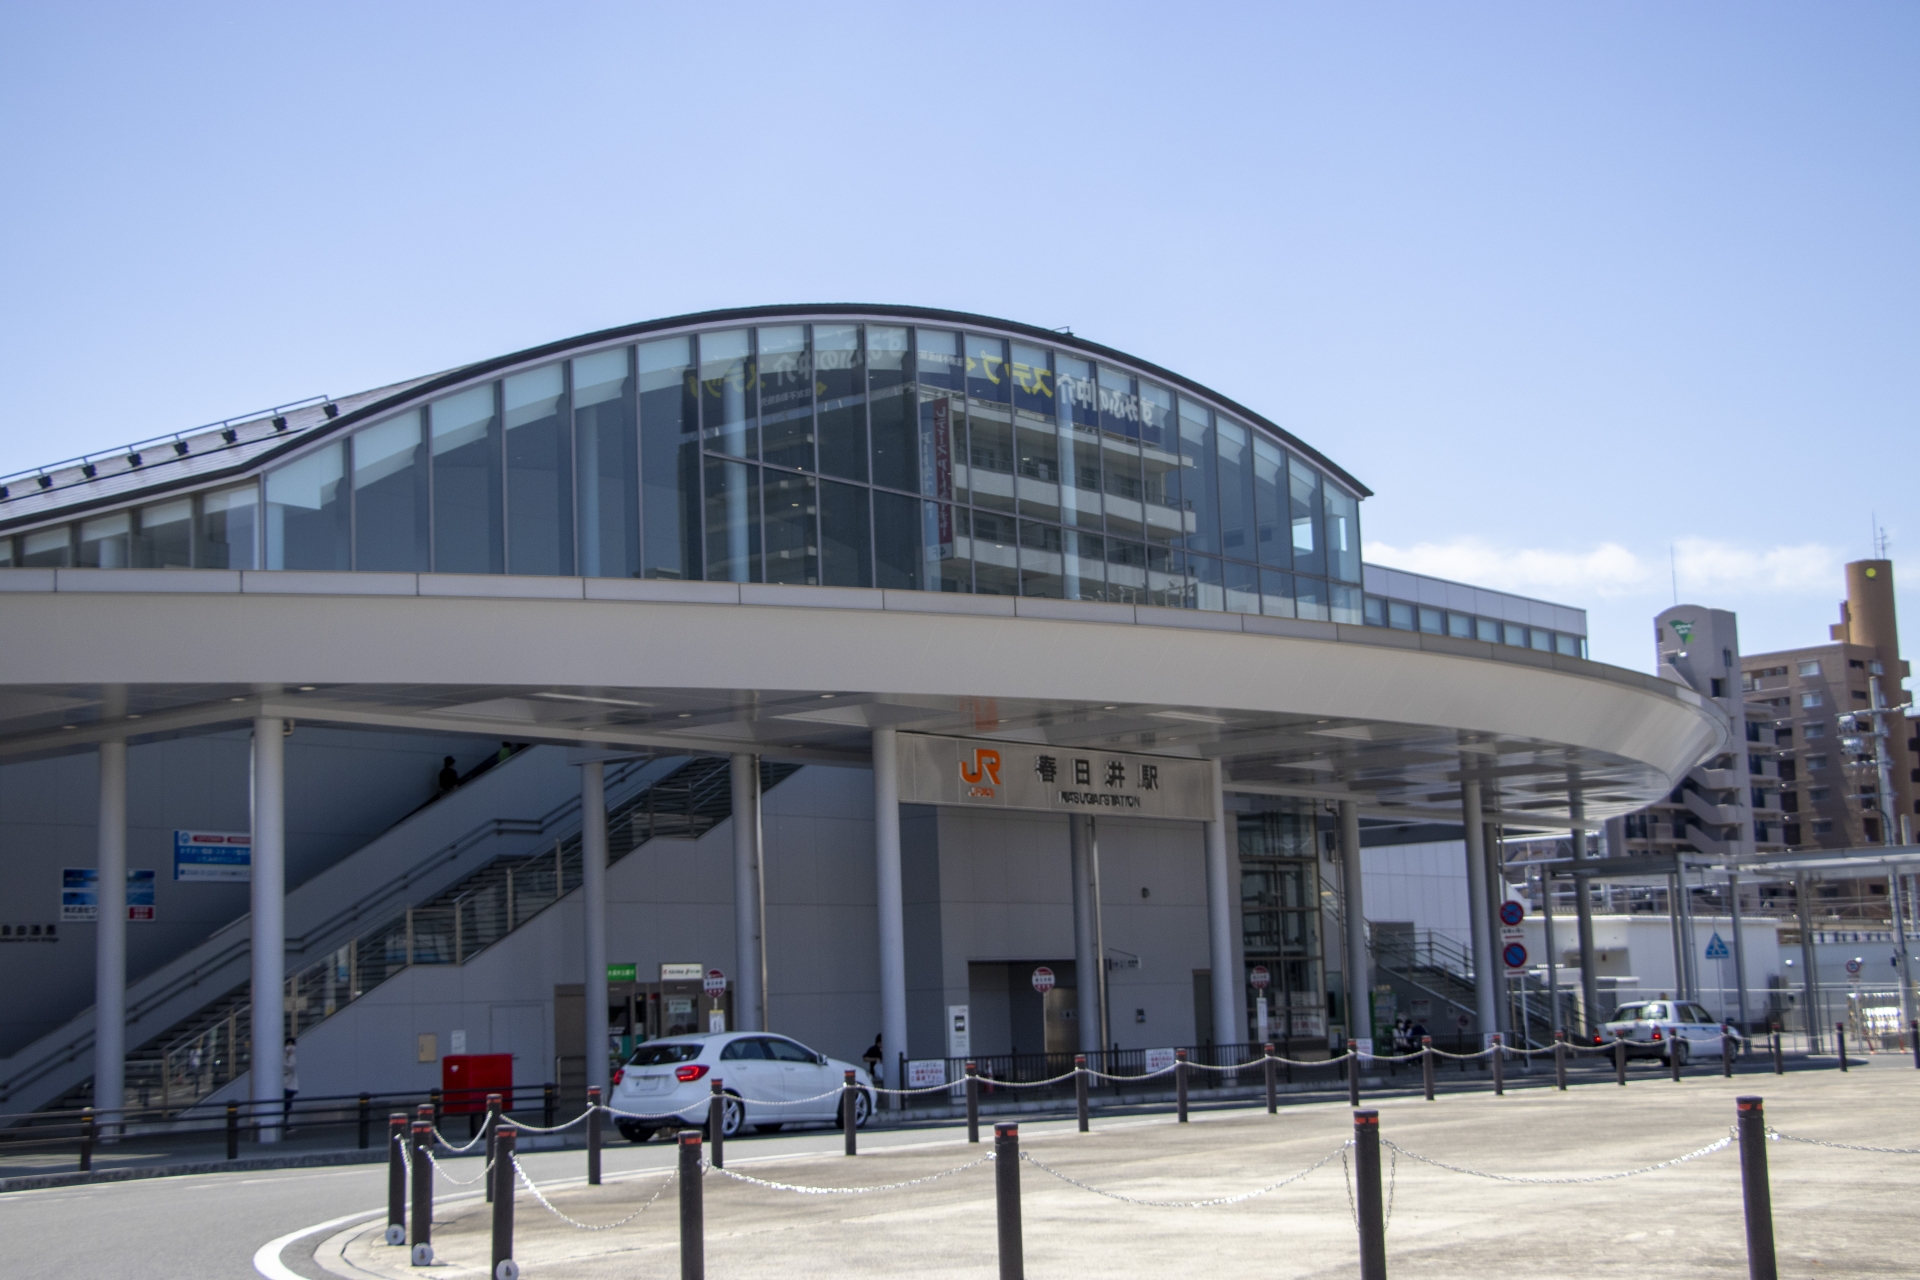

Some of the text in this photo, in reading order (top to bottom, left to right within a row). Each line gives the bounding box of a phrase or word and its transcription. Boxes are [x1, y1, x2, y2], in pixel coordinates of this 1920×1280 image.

[959, 748, 1001, 785] JR
[1035, 754, 1159, 791] 春日井駅
[1103, 794, 1141, 808] STATION
